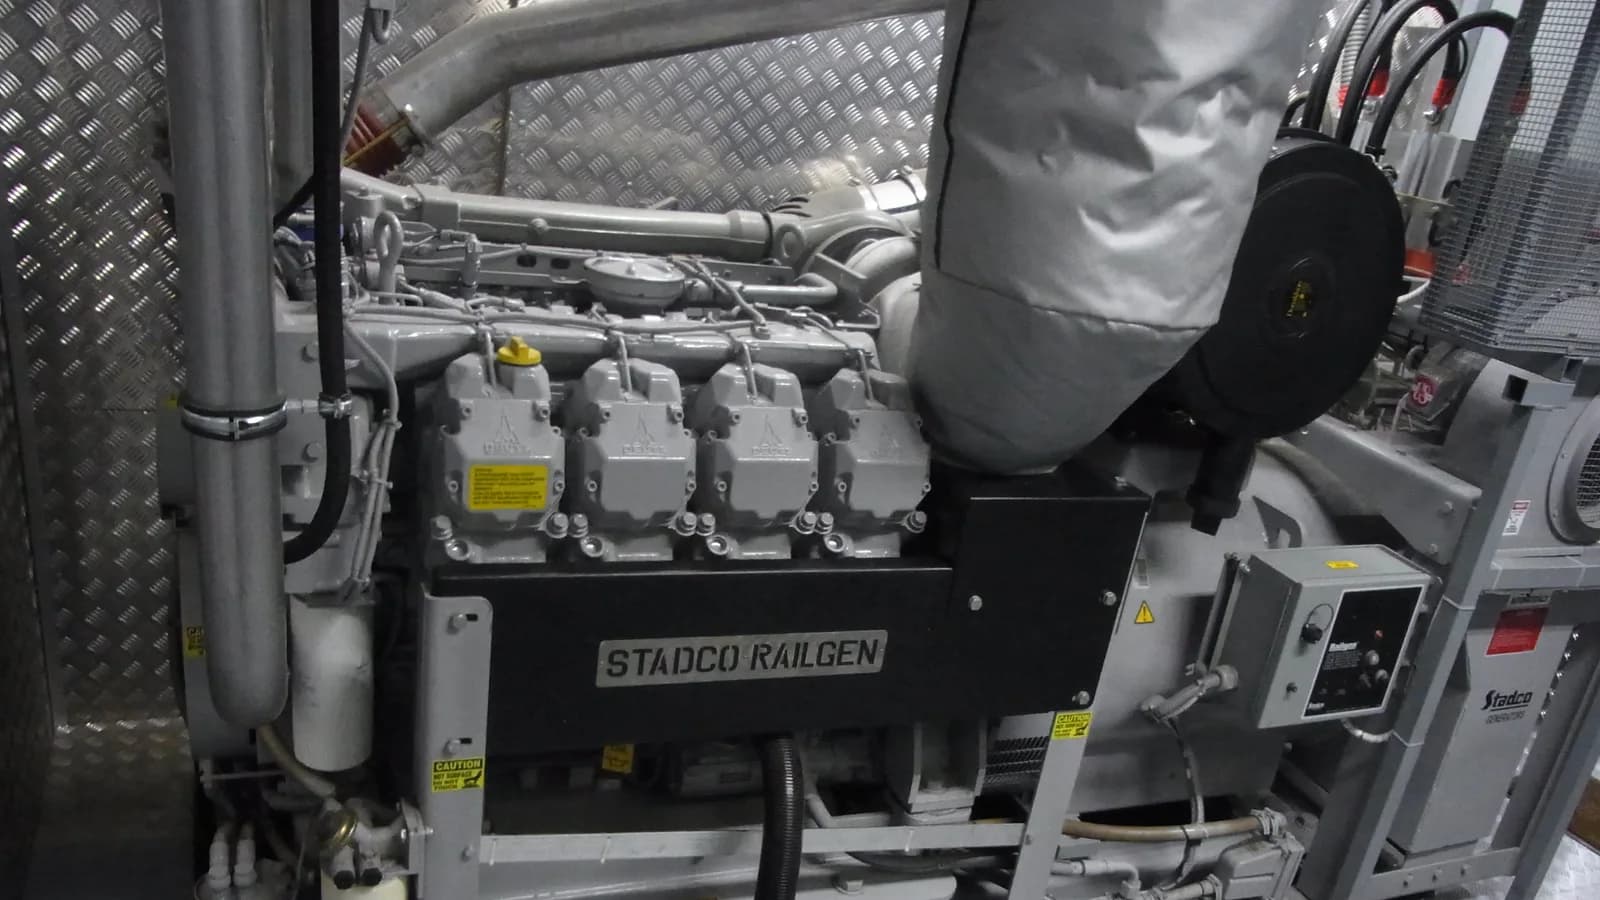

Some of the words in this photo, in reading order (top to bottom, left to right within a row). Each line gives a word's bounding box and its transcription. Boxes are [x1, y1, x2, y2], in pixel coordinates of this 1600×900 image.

[606, 645, 739, 677] STADCO
[751, 639, 879, 671] RAILGEN
[1480, 690, 1533, 710] Stadco
[435, 760, 481, 771] CAUTION
